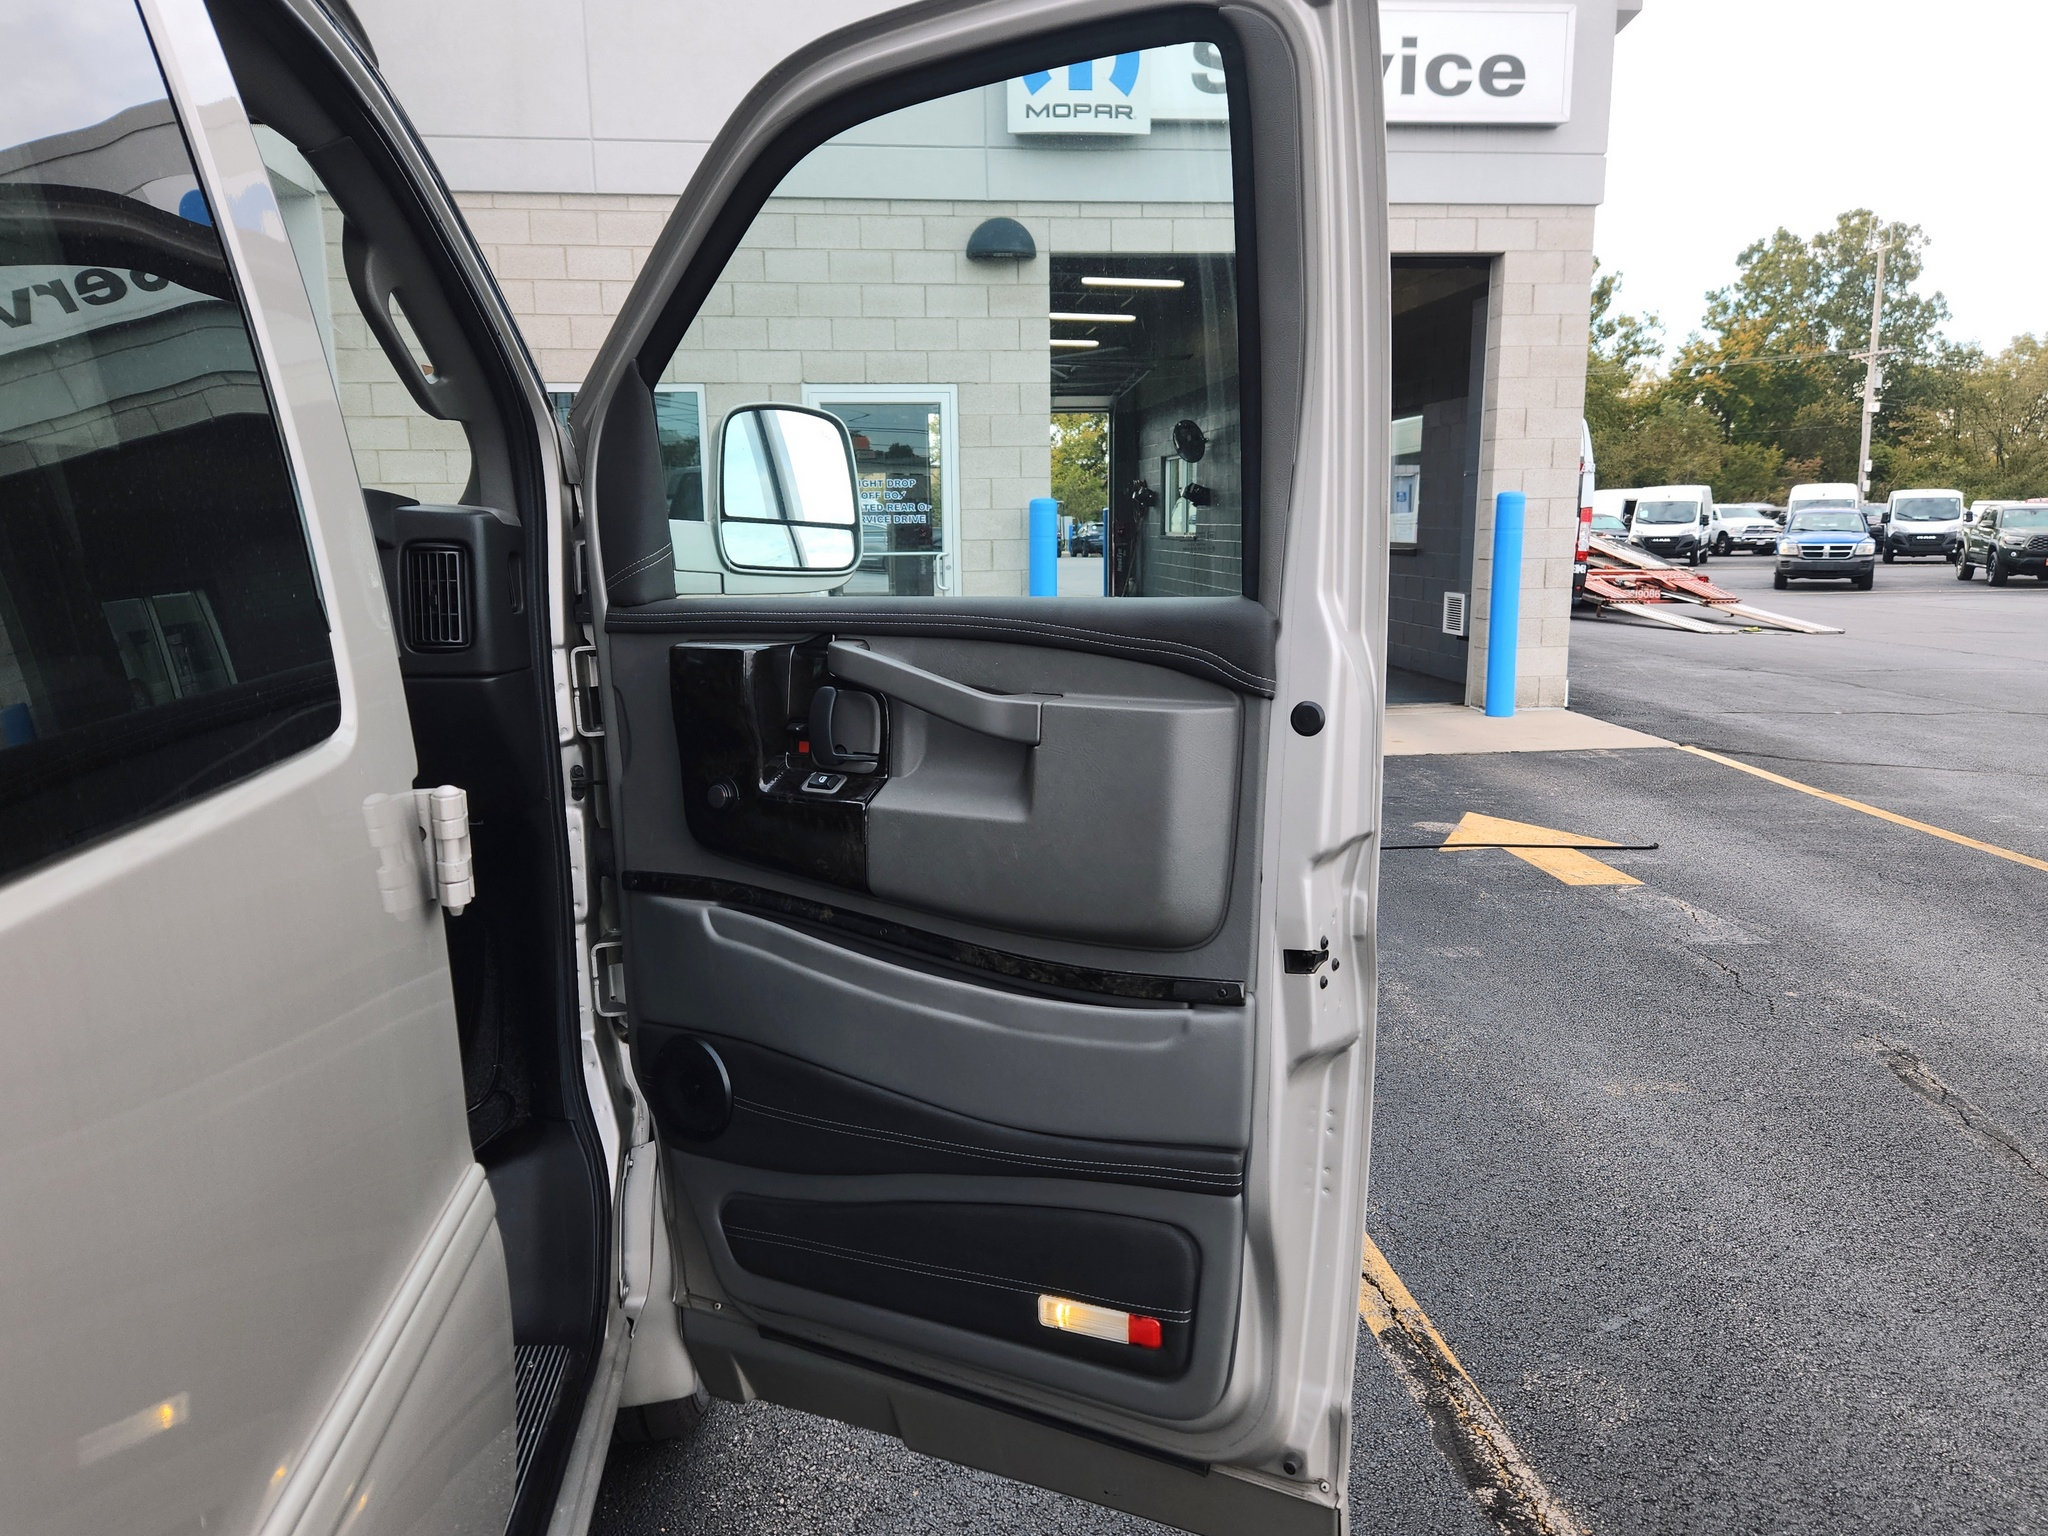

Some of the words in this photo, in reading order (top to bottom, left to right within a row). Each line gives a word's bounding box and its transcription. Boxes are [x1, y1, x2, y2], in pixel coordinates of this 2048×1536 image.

[1026, 103, 1133, 120] MOPAR
[886, 479, 916, 488] DROP
[860, 491, 881, 500] OFF
[886, 503, 916, 512] REAR
[894, 515, 926, 524] DRIVE
